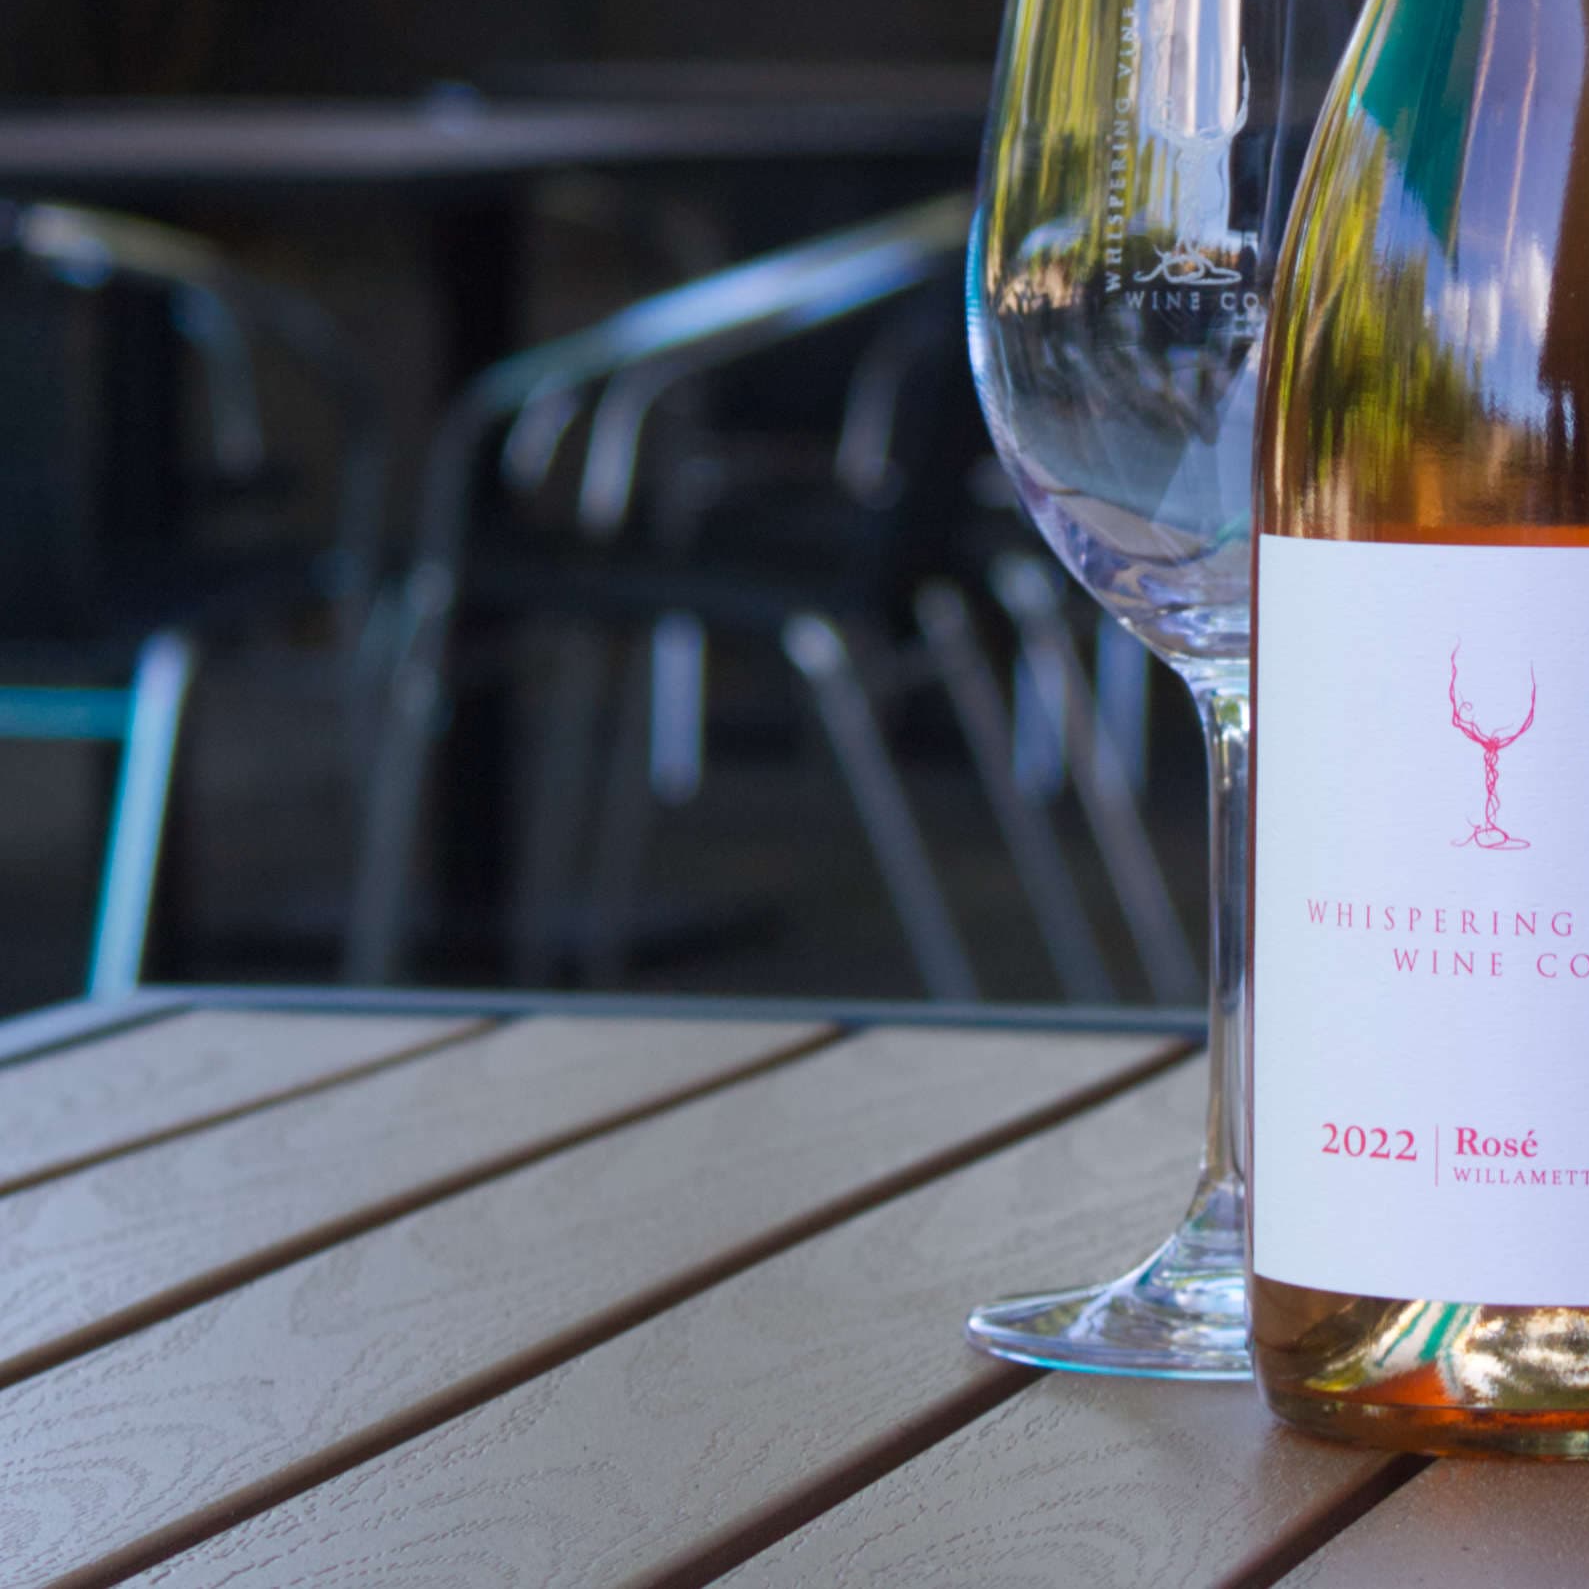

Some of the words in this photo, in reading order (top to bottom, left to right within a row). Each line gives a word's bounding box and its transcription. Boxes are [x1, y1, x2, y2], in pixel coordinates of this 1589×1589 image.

[1104, 97, 1134, 293] WHISPERING
[1125, 290, 1201, 311] WINE
[1306, 898, 1575, 938] WHISPERING
[1392, 948, 1504, 978] WINE
[1320, 1121, 1419, 1163] 2022
[1454, 1123, 1540, 1160] Rosé
